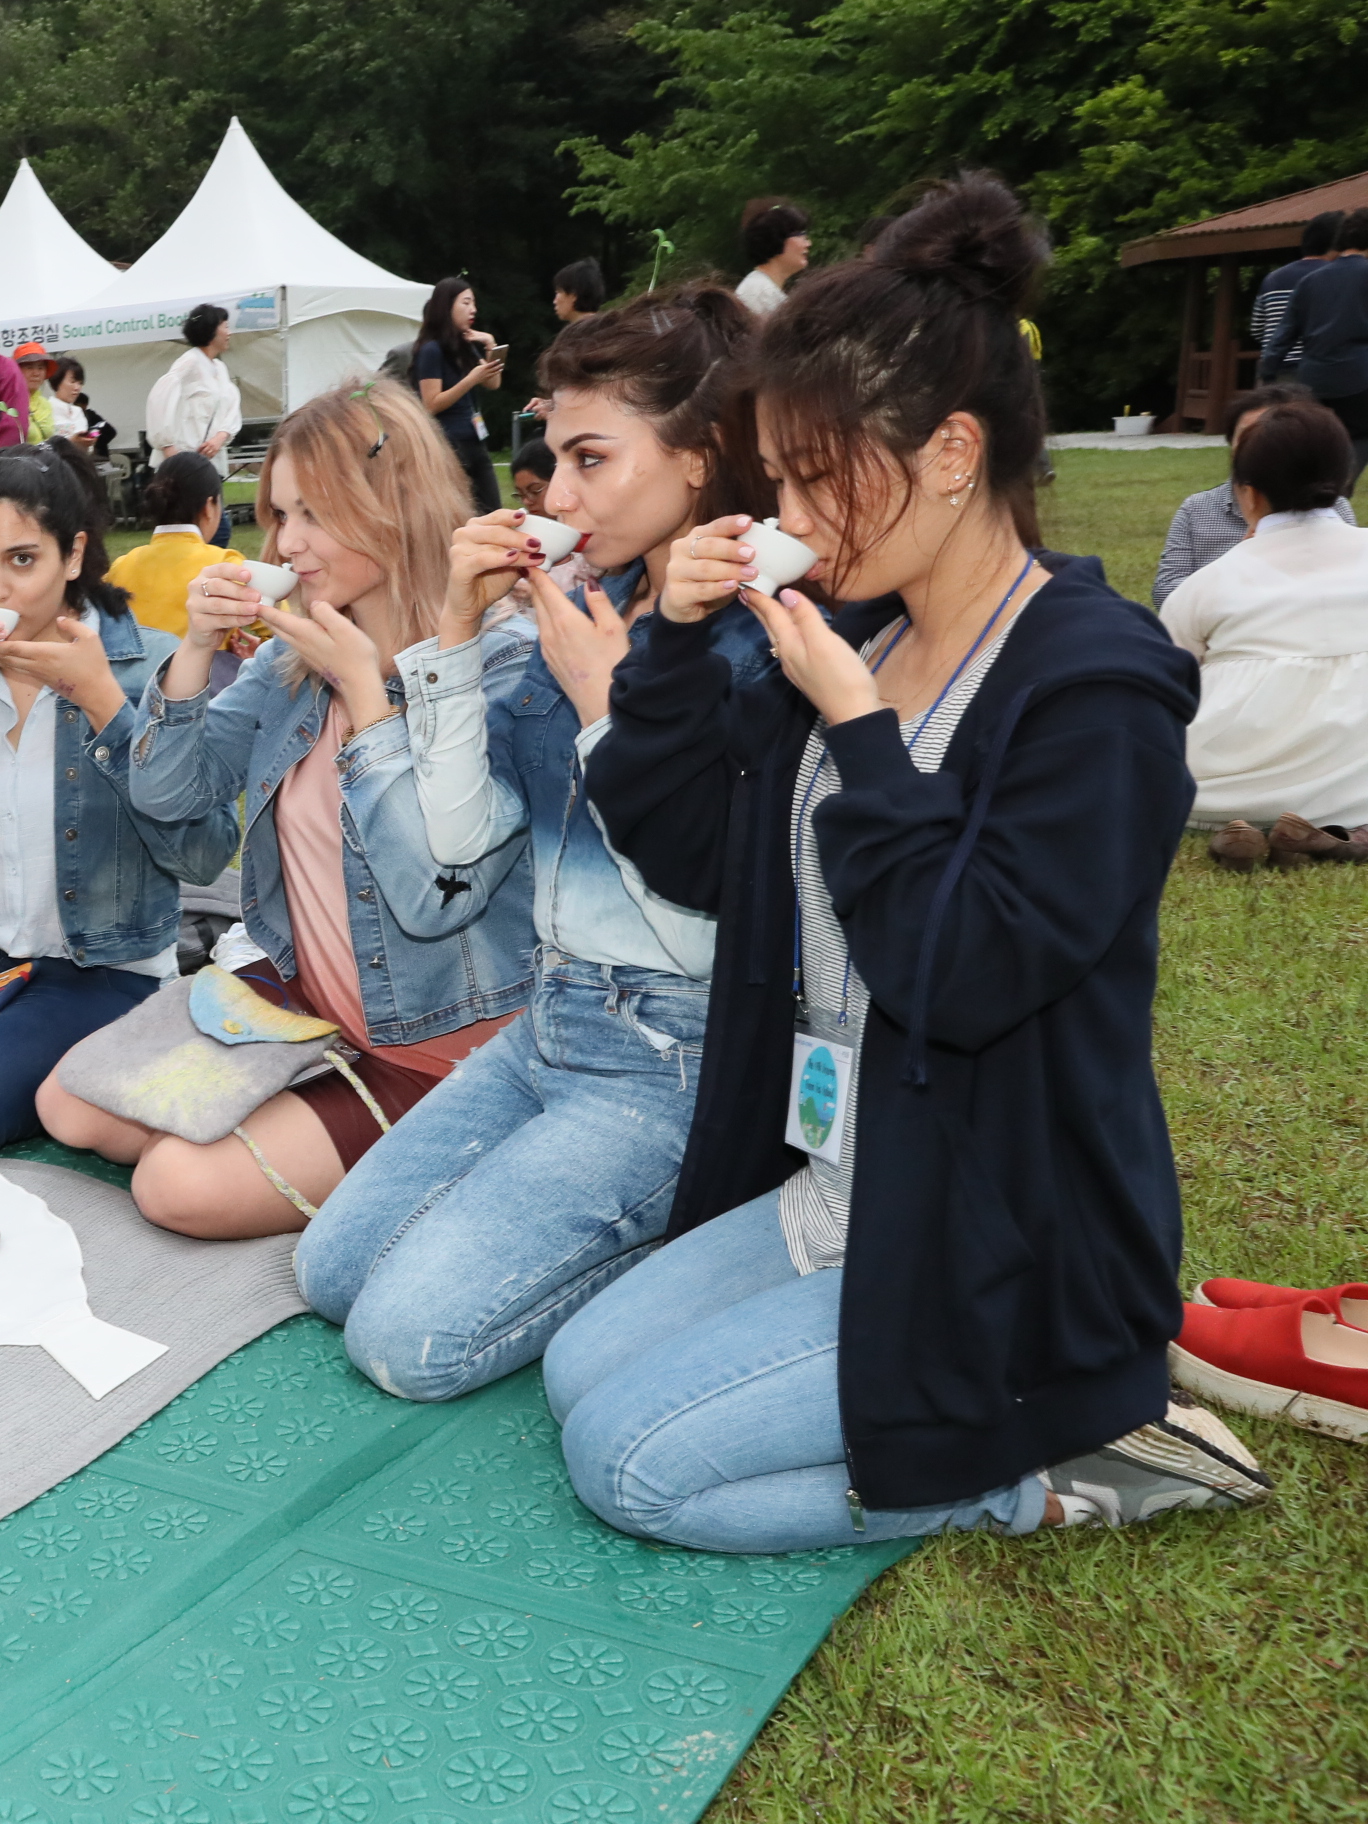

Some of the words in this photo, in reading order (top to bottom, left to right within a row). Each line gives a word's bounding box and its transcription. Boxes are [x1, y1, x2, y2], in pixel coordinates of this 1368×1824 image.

[62, 321, 102, 338] Sound
[105, 315, 153, 334] Control
[157, 313, 189, 328] Boot
